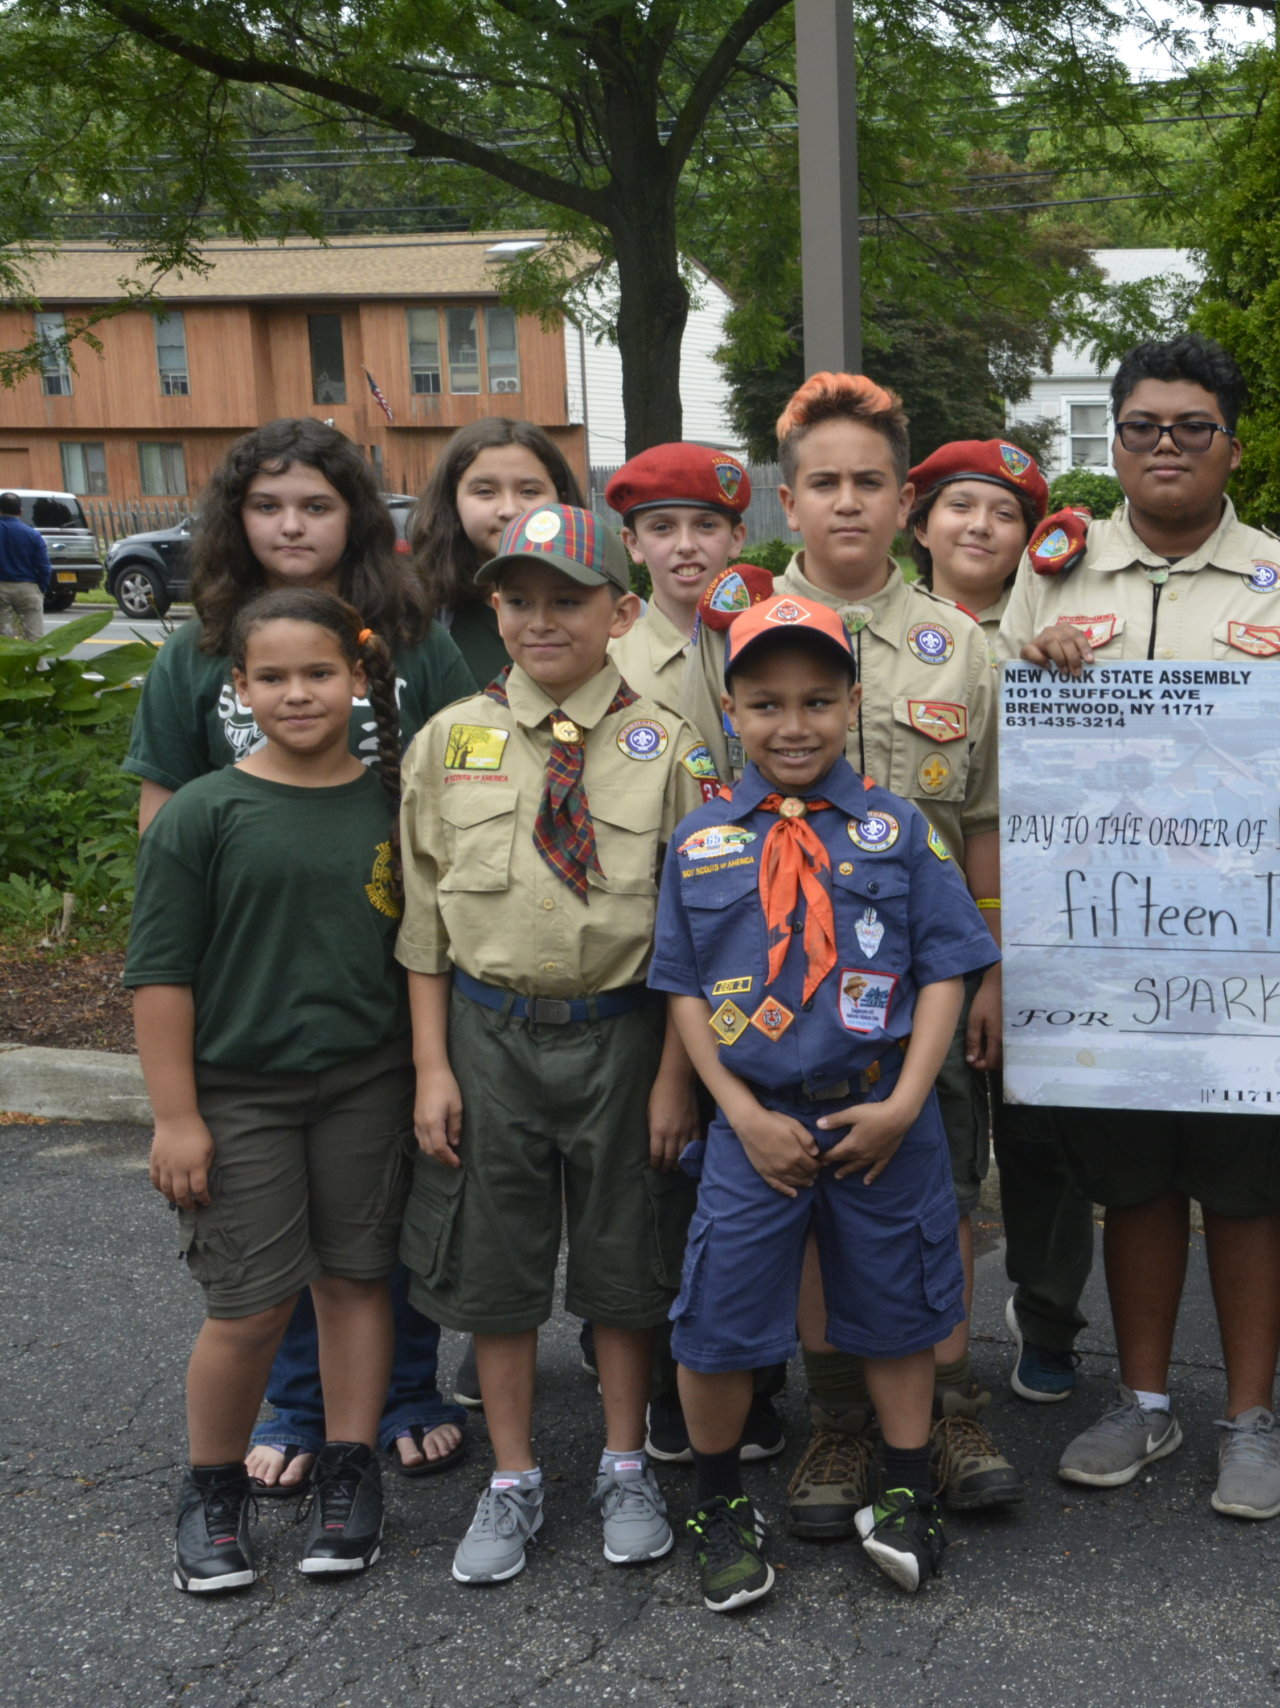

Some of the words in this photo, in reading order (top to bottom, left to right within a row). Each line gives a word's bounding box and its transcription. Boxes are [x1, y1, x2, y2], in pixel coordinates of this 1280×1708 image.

[703, 577, 719, 606] TROOP
[1004, 669, 1043, 684] NEW
[1048, 670, 1095, 684] YORK
[1100, 670, 1154, 684] STATE
[1158, 670, 1252, 685] ASSEMBLY
[1005, 688, 1053, 699] 1010
[1058, 688, 1153, 700] SUFFOLK
[1159, 689, 1201, 700] AVE
[1005, 703, 1125, 716] BRENTWOOD,
[1130, 704, 1157, 716] NY
[1163, 704, 1215, 716] 11717
[1005, 717, 1126, 728] 631-435-3214
[1007, 814, 1055, 852] PAY
[1061, 816, 1089, 846] TO
[1096, 813, 1143, 847] THE
[1149, 816, 1230, 849] ORDER
[1236, 818, 1268, 856] OF
[1058, 869, 1239, 942] fifteen
[736, 980, 743, 990] 2
[1011, 1008, 1114, 1029] FOR
